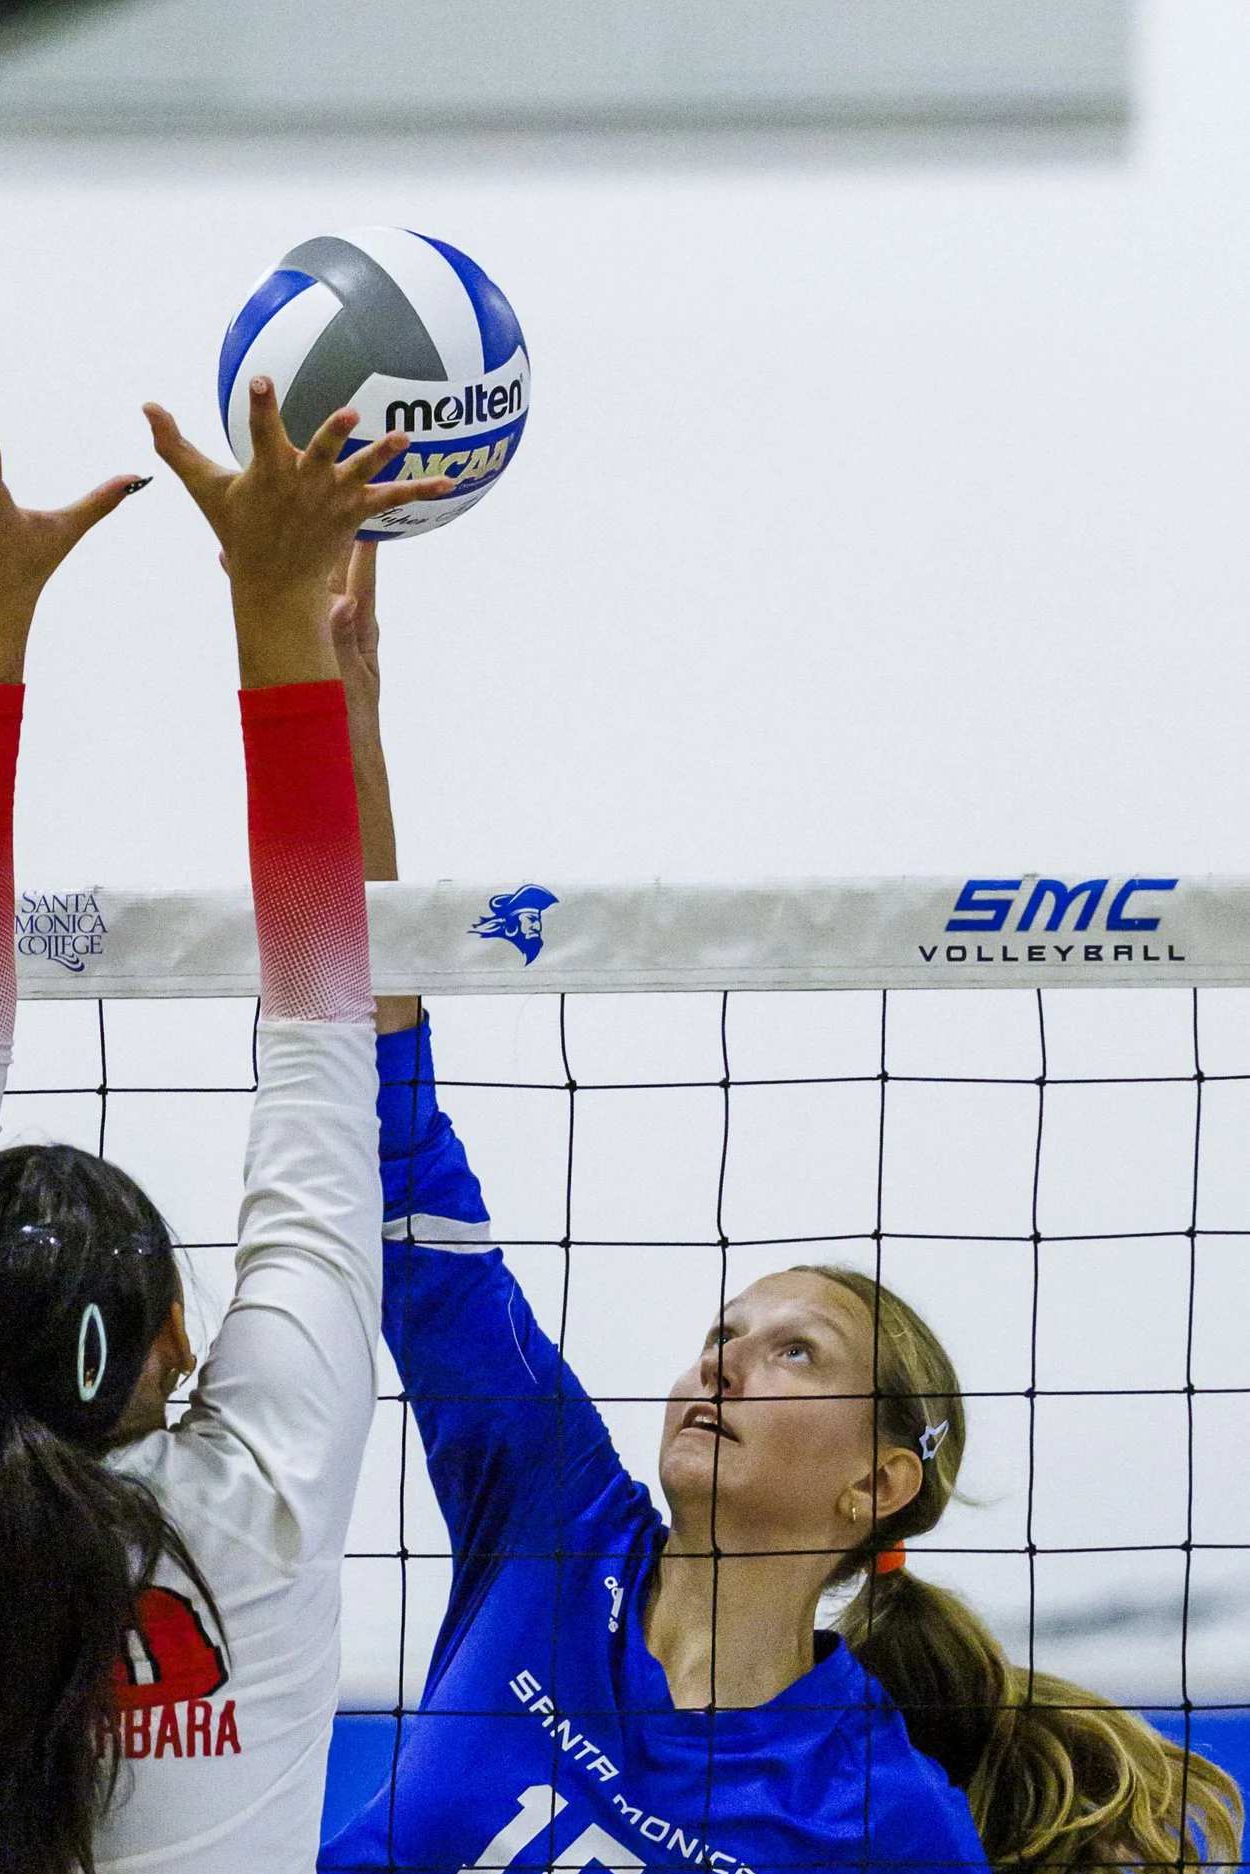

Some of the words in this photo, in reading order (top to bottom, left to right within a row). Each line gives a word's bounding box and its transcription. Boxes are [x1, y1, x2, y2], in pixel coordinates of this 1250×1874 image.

[385, 379, 522, 433] molten
[395, 436, 510, 485] NCAA
[15, 914, 108, 934] MONICA
[21, 891, 99, 914] SANTA
[944, 878, 1180, 932] SMC
[18, 935, 104, 972] COLLEGE
[918, 944, 1186, 962] VOLLEYBALL
[508, 1669, 620, 1782] SANTA
